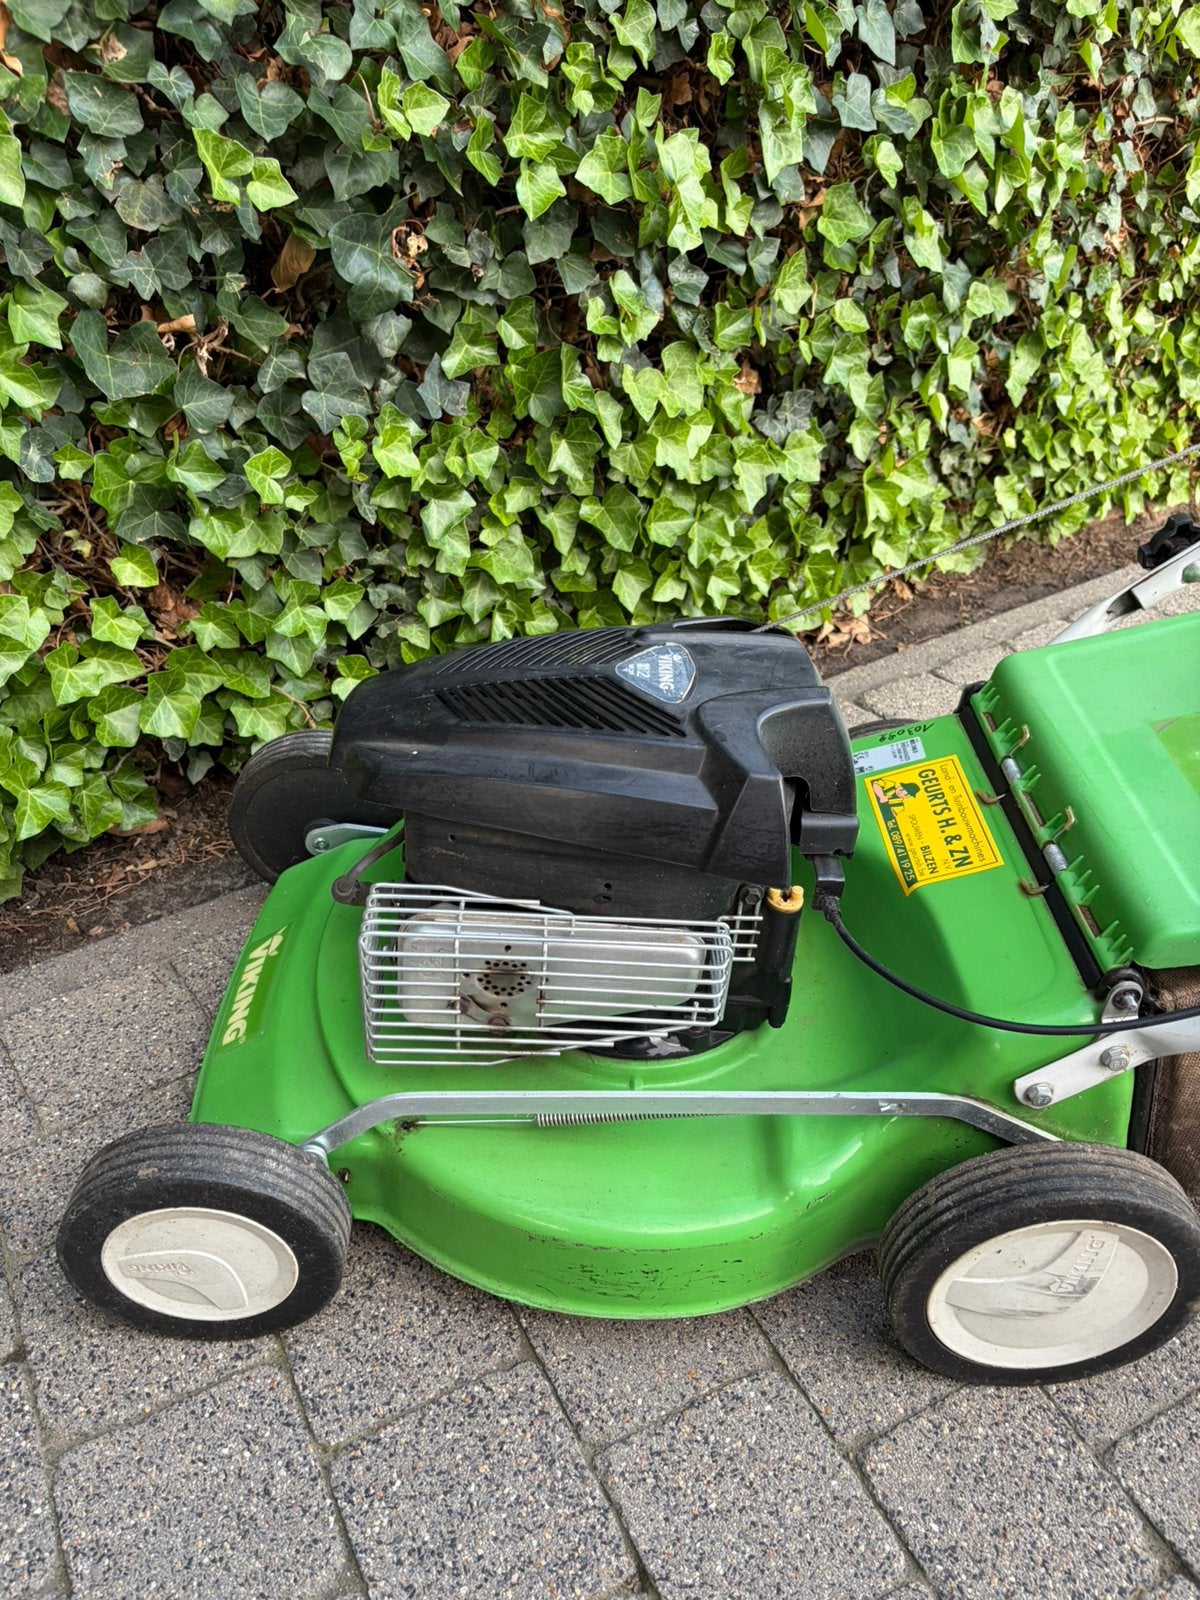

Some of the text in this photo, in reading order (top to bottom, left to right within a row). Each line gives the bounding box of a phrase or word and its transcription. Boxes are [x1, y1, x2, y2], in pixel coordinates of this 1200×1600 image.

[658, 655, 675, 691] VIKING
[918, 768, 973, 868] GEURTS H. & ZN
[949, 784, 957, 793] en
[953, 794, 986, 862] Tuinbouwmachines
[890, 831, 907, 858] 089/41
[920, 845, 939, 875] BILZEN
[901, 859, 911, 868] 19
[904, 869, 915, 882] 25
[222, 935, 275, 1046] VIKING
